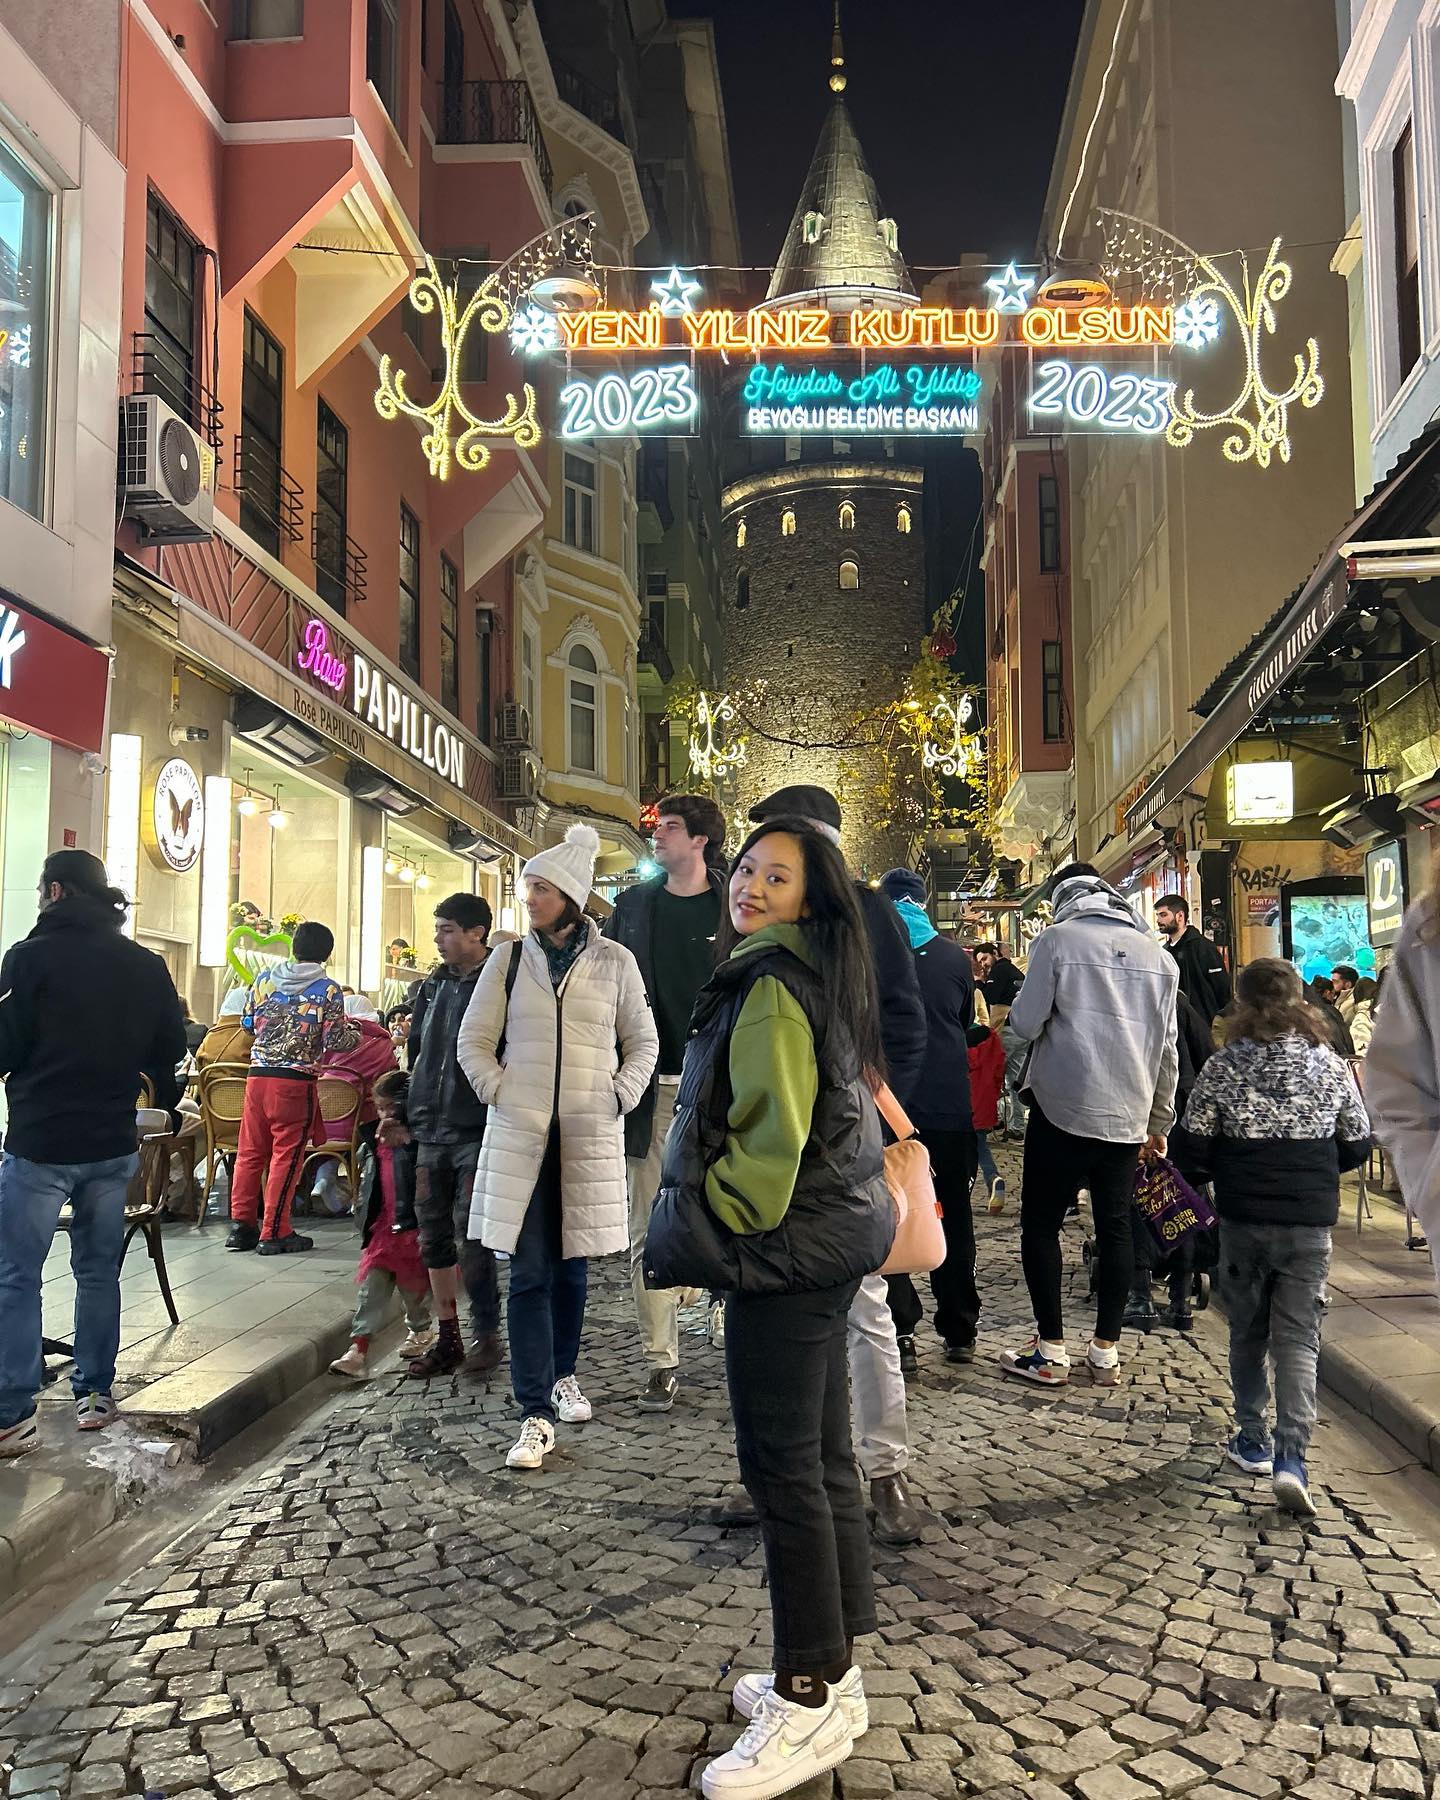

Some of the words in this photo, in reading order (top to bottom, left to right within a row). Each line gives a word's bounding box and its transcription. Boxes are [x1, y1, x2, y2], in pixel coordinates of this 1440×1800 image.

[558, 301, 662, 348] YENİ
[683, 310, 830, 347] YILINIZ
[850, 308, 999, 346] KUTLU
[1022, 306, 1175, 344] OLSUN
[560, 364, 698, 437] 2023
[744, 364, 843, 401] Haydar
[1027, 360, 1174, 433] 2023
[827, 404, 903, 429] BELEDİYE
[298, 619, 347, 691] Rose
[293, 688, 317, 723] Rose
[320, 704, 367, 756] PAPILLON
[353, 653, 464, 789] PAPILLON
[159, 767, 174, 797] ROSE
[175, 765, 202, 811] PAPILLON
[1179, 1215, 1199, 1231] ATIK
